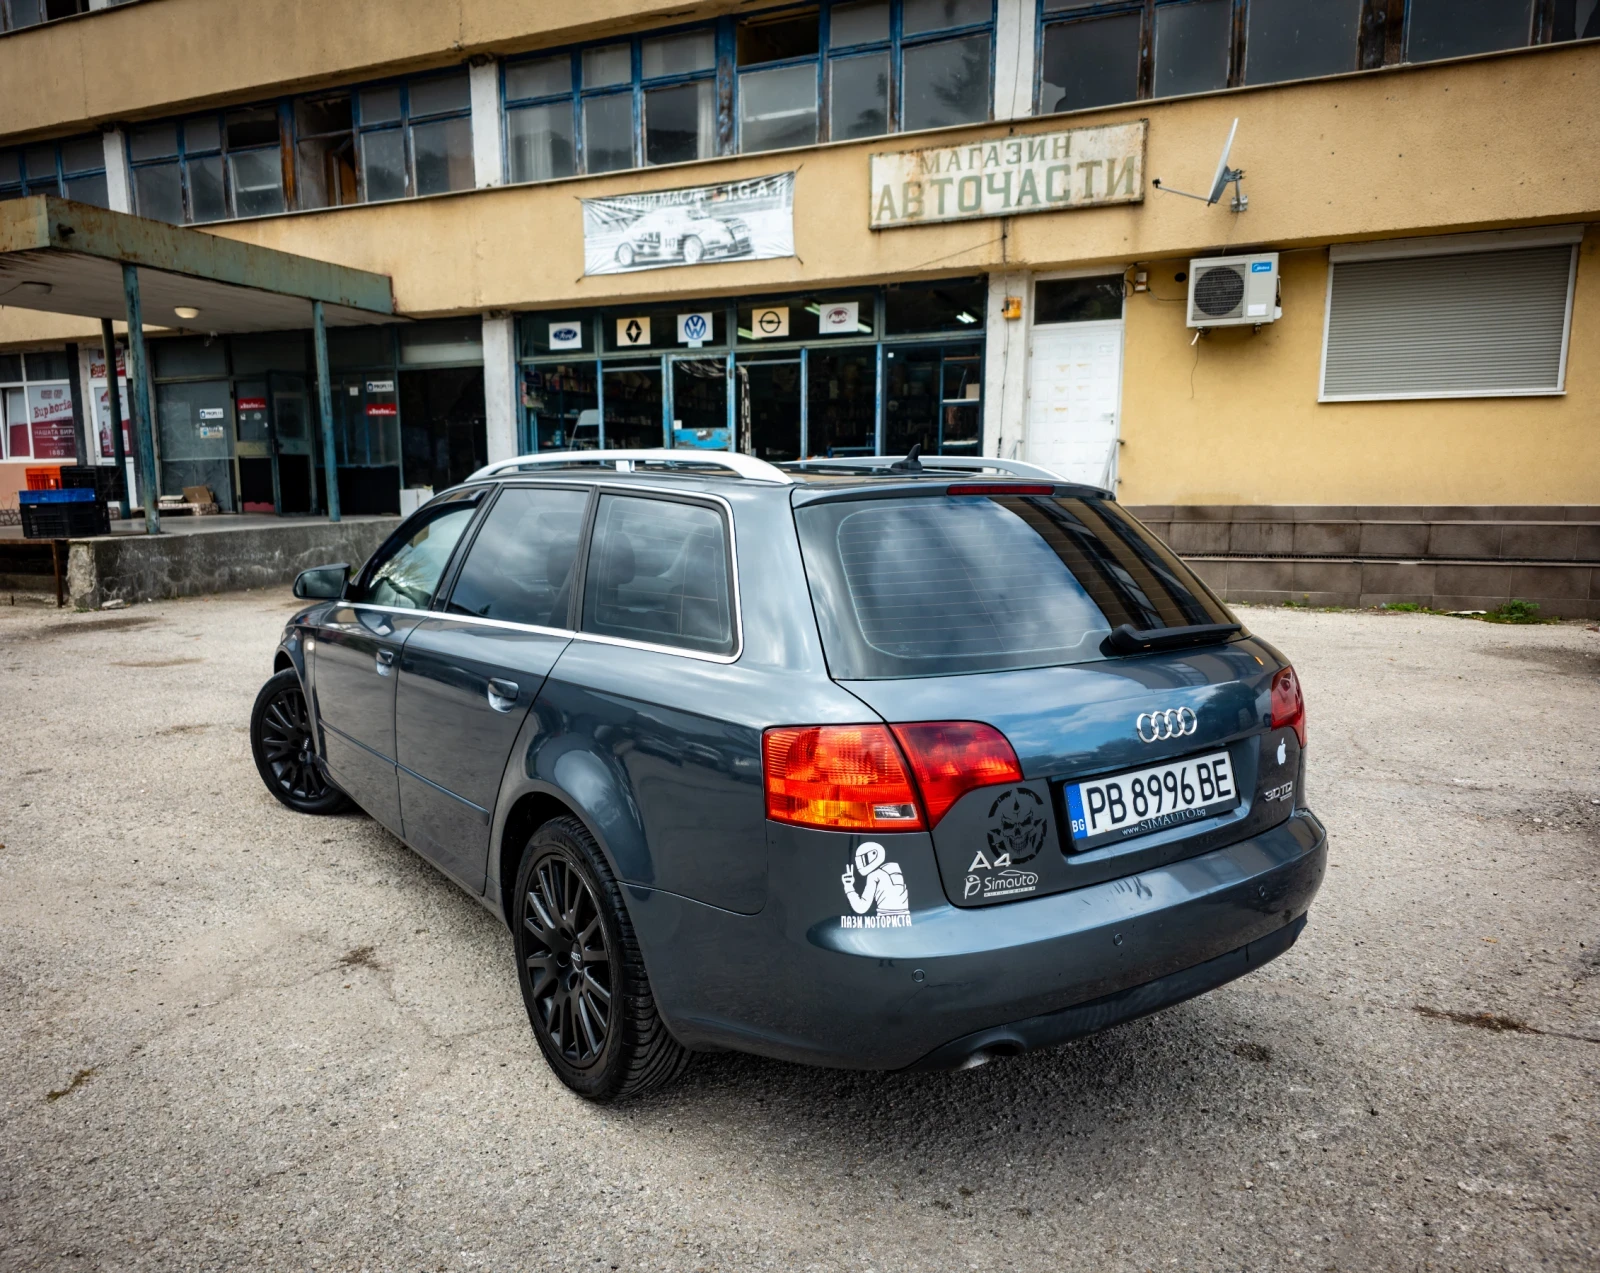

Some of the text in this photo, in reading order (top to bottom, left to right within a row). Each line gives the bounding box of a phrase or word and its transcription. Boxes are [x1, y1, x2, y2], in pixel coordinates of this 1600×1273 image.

[920, 136, 1072, 175] МАГАЗИН
[875, 155, 1135, 221] АВТОЧАСТИ
[664, 237, 676, 249] 147
[33, 399, 72, 419] Euphoria
[1086, 758, 1232, 829] PB 8996 BE
[1071, 819, 1085, 833] BG
[1121, 807, 1206, 836] www.SIMAUTO.bg
[968, 850, 1011, 872] A4
[984, 874, 1035, 891] Simauto
[840, 914, 912, 929] ПАЗИ МОТОРИСТА
